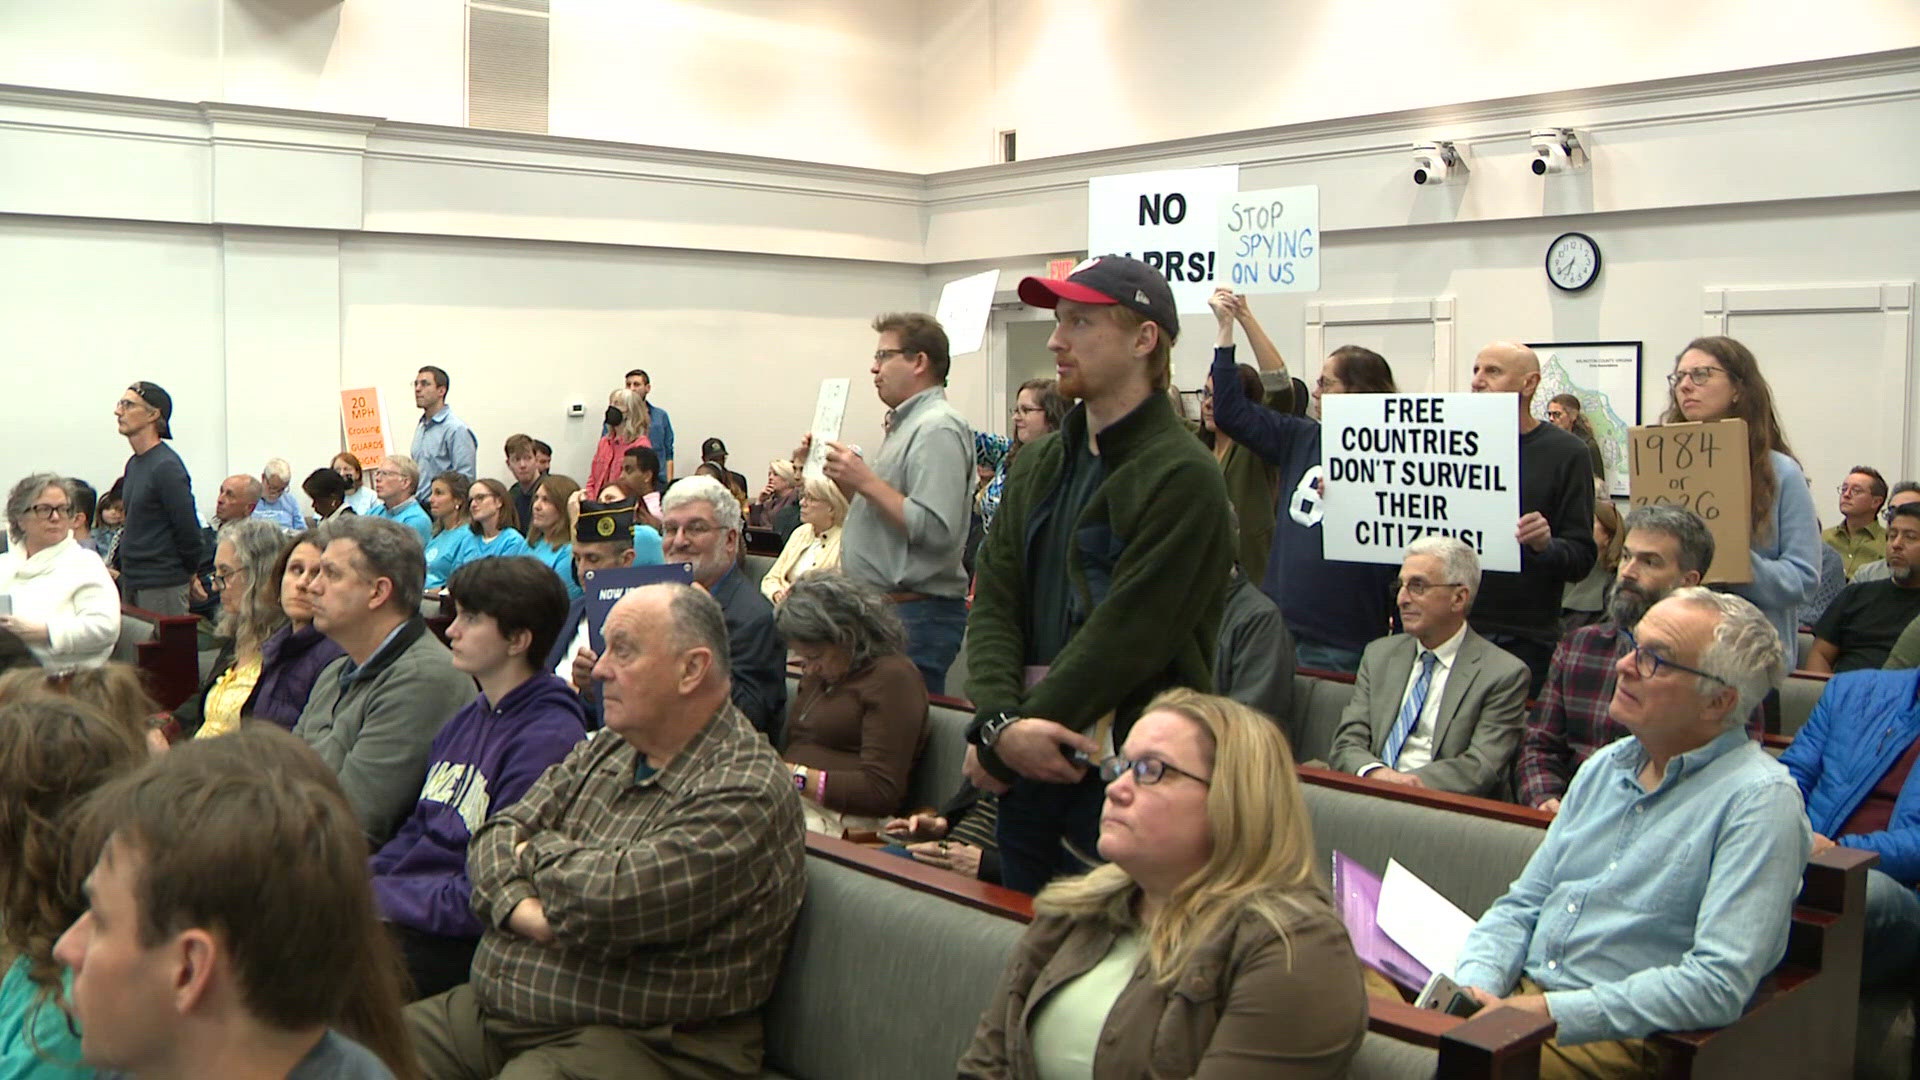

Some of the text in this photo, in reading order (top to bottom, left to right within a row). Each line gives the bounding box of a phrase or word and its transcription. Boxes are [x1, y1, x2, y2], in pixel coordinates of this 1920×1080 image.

[1139, 193, 1187, 226] NO
[1228, 201, 1283, 232] STOP
[1235, 228, 1314, 259] SPYING
[1232, 261, 1295, 285] ON US
[351, 396, 366, 409] 20
[351, 407, 375, 420] MPH
[1384, 398, 1444, 423] FREE
[348, 426, 381, 436] Crossing
[1342, 427, 1479, 457] COUNTRIES
[1634, 432, 1722, 476] 1984
[1330, 457, 1507, 492] DON'T SURVEIL
[1669, 475, 1692, 490] or
[1375, 491, 1448, 521] THEIR
[598, 587, 624, 600] NOW
